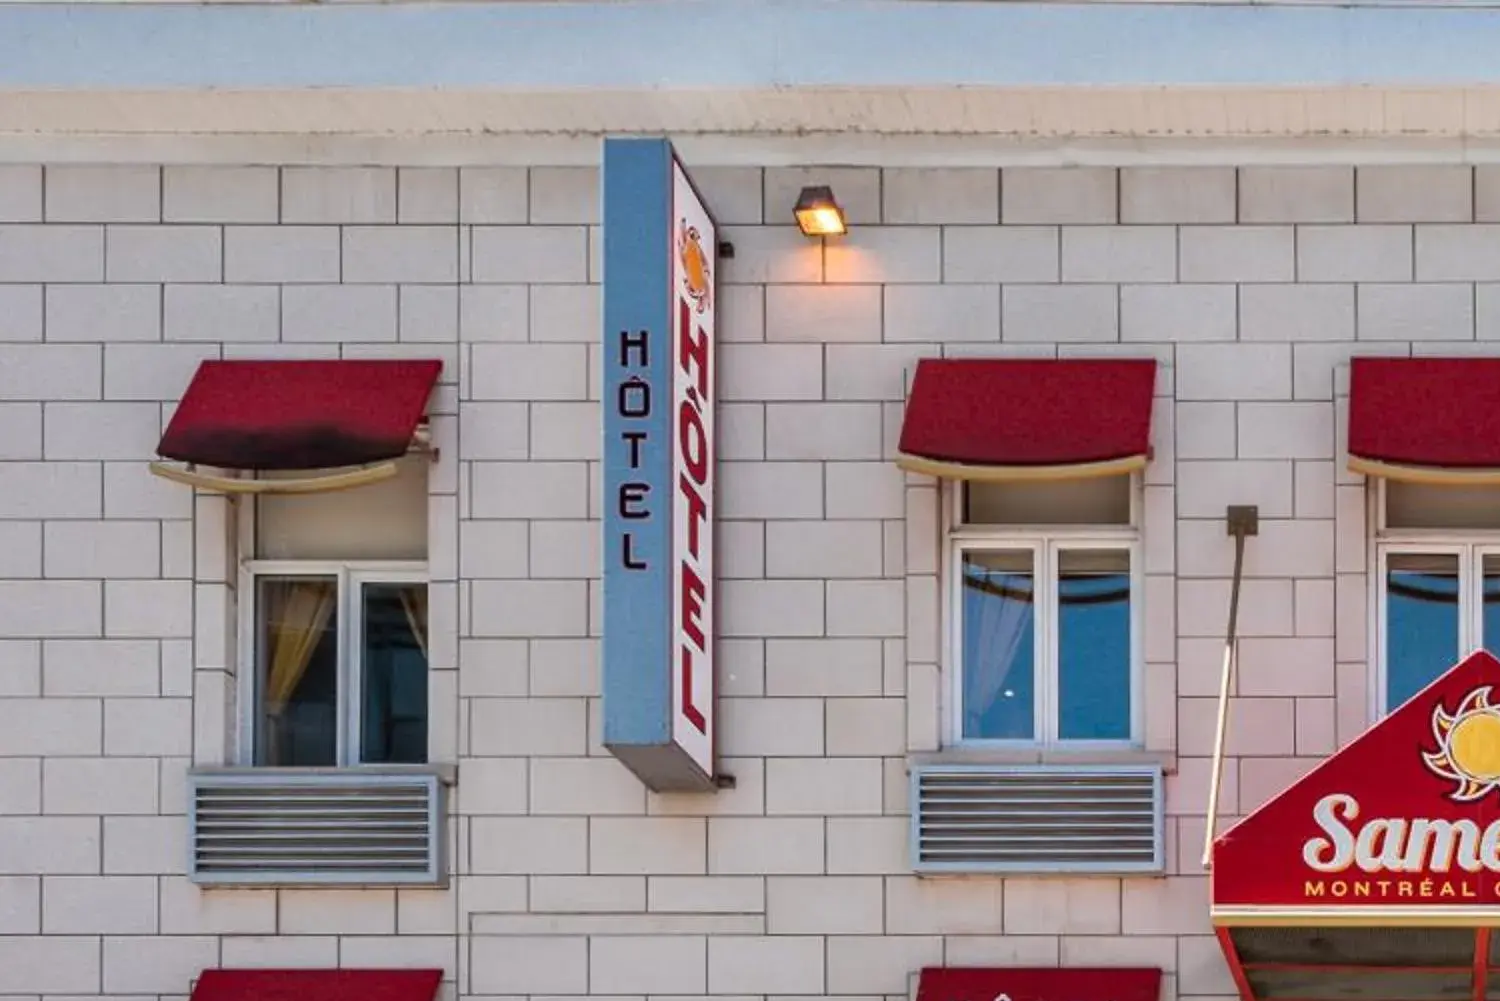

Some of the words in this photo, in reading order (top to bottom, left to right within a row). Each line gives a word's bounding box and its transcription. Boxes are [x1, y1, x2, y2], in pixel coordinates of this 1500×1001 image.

[619, 330, 651, 571] HÔTEL
[679, 297, 710, 735] HÔTEL
[1304, 877, 1476, 898] MONTRÉAL
